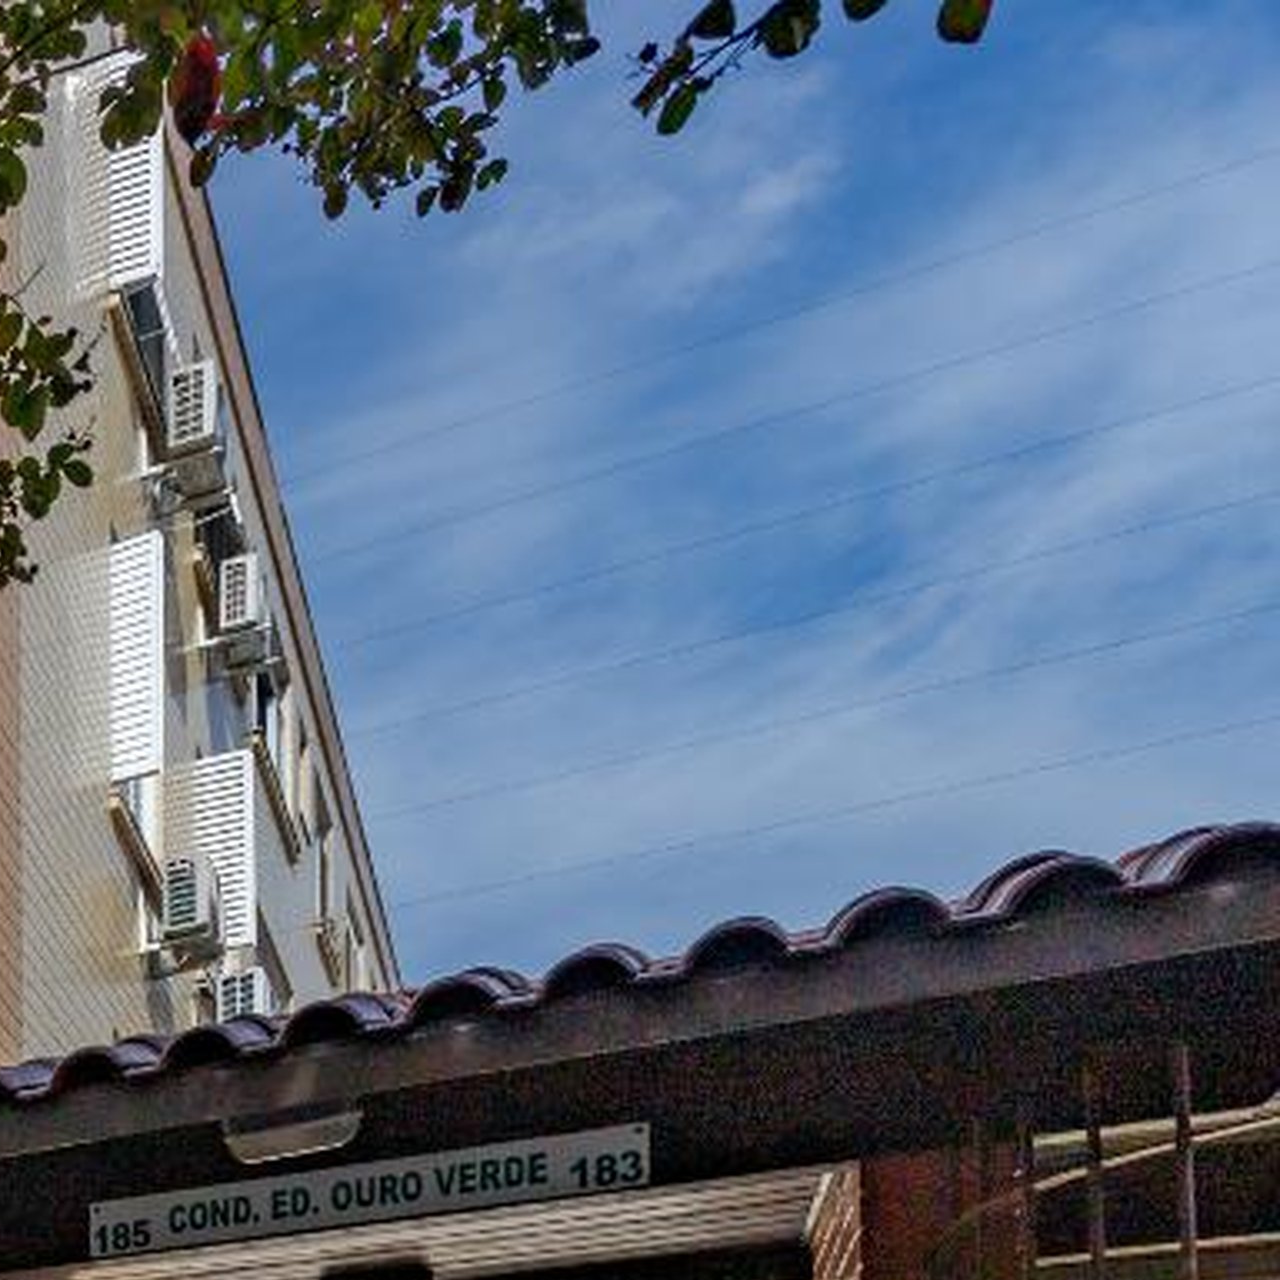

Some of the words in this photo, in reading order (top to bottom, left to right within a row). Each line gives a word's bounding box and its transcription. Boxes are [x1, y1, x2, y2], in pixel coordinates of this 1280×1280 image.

[94, 1219, 151, 1254] 185
[168, 1197, 260, 1235] COND.
[271, 1186, 318, 1221] ED.
[331, 1170, 423, 1212] OURO
[433, 1151, 548, 1196] VERDE
[568, 1149, 641, 1189] 183
